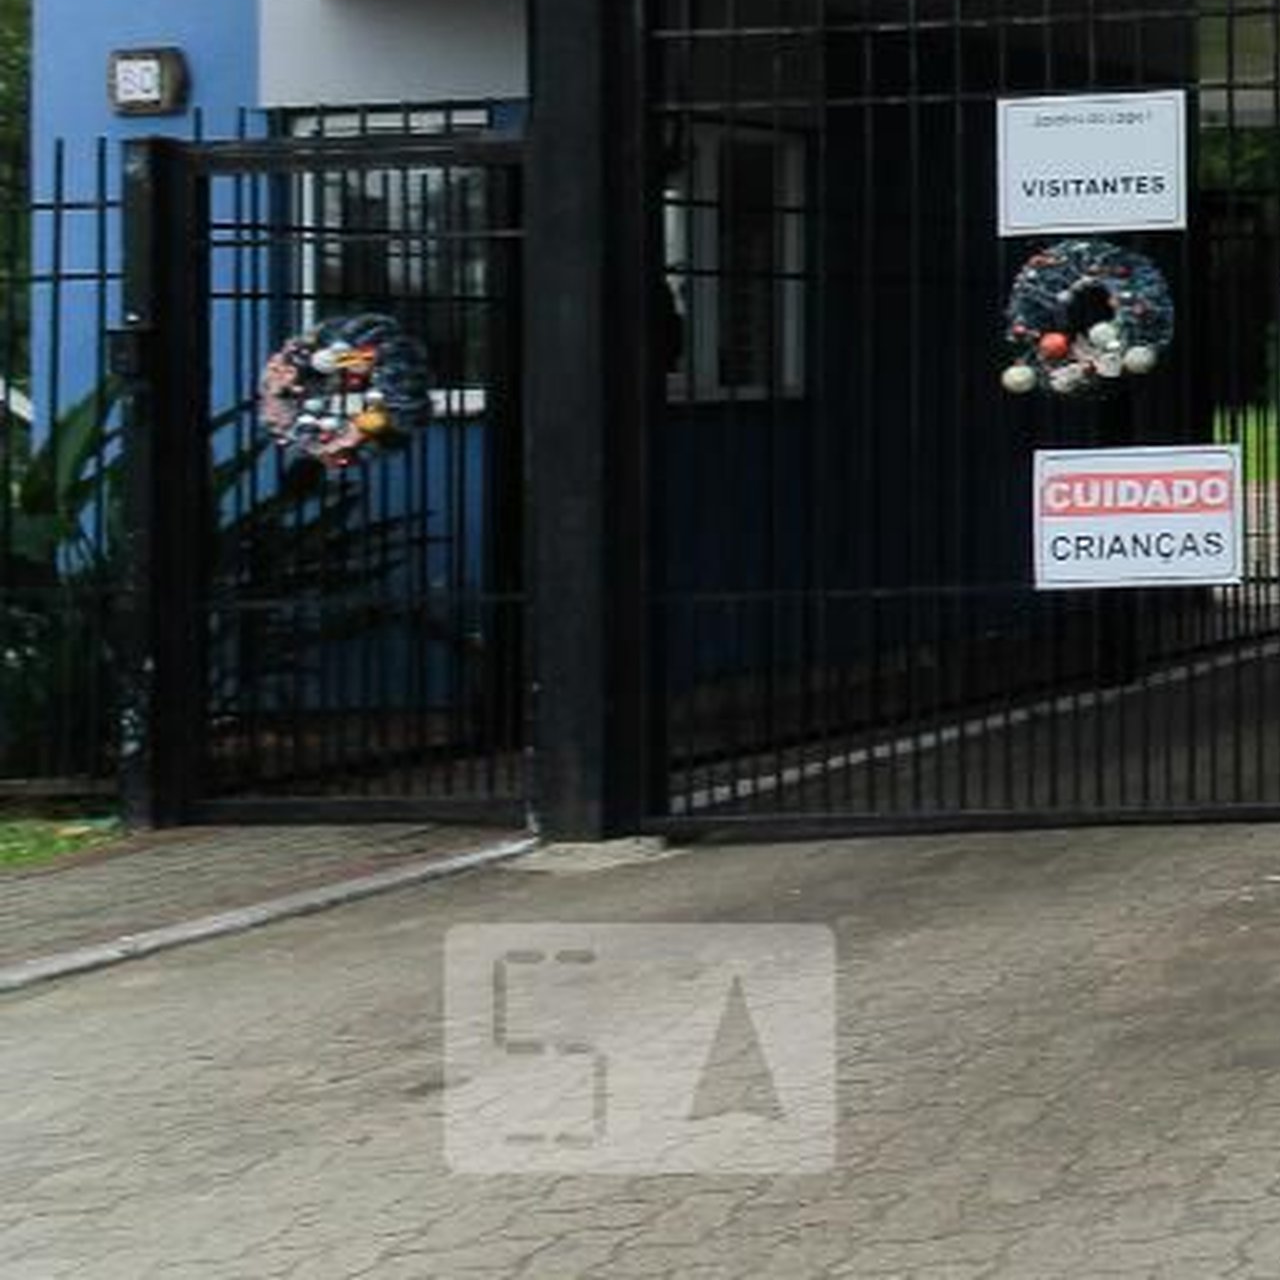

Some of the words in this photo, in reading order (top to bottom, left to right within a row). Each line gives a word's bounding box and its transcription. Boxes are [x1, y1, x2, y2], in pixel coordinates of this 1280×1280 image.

[1022, 175, 1166, 198] VISITANTES
[1043, 477, 1229, 509] CUIDADO
[1051, 531, 1225, 564] CRIANÇAS
